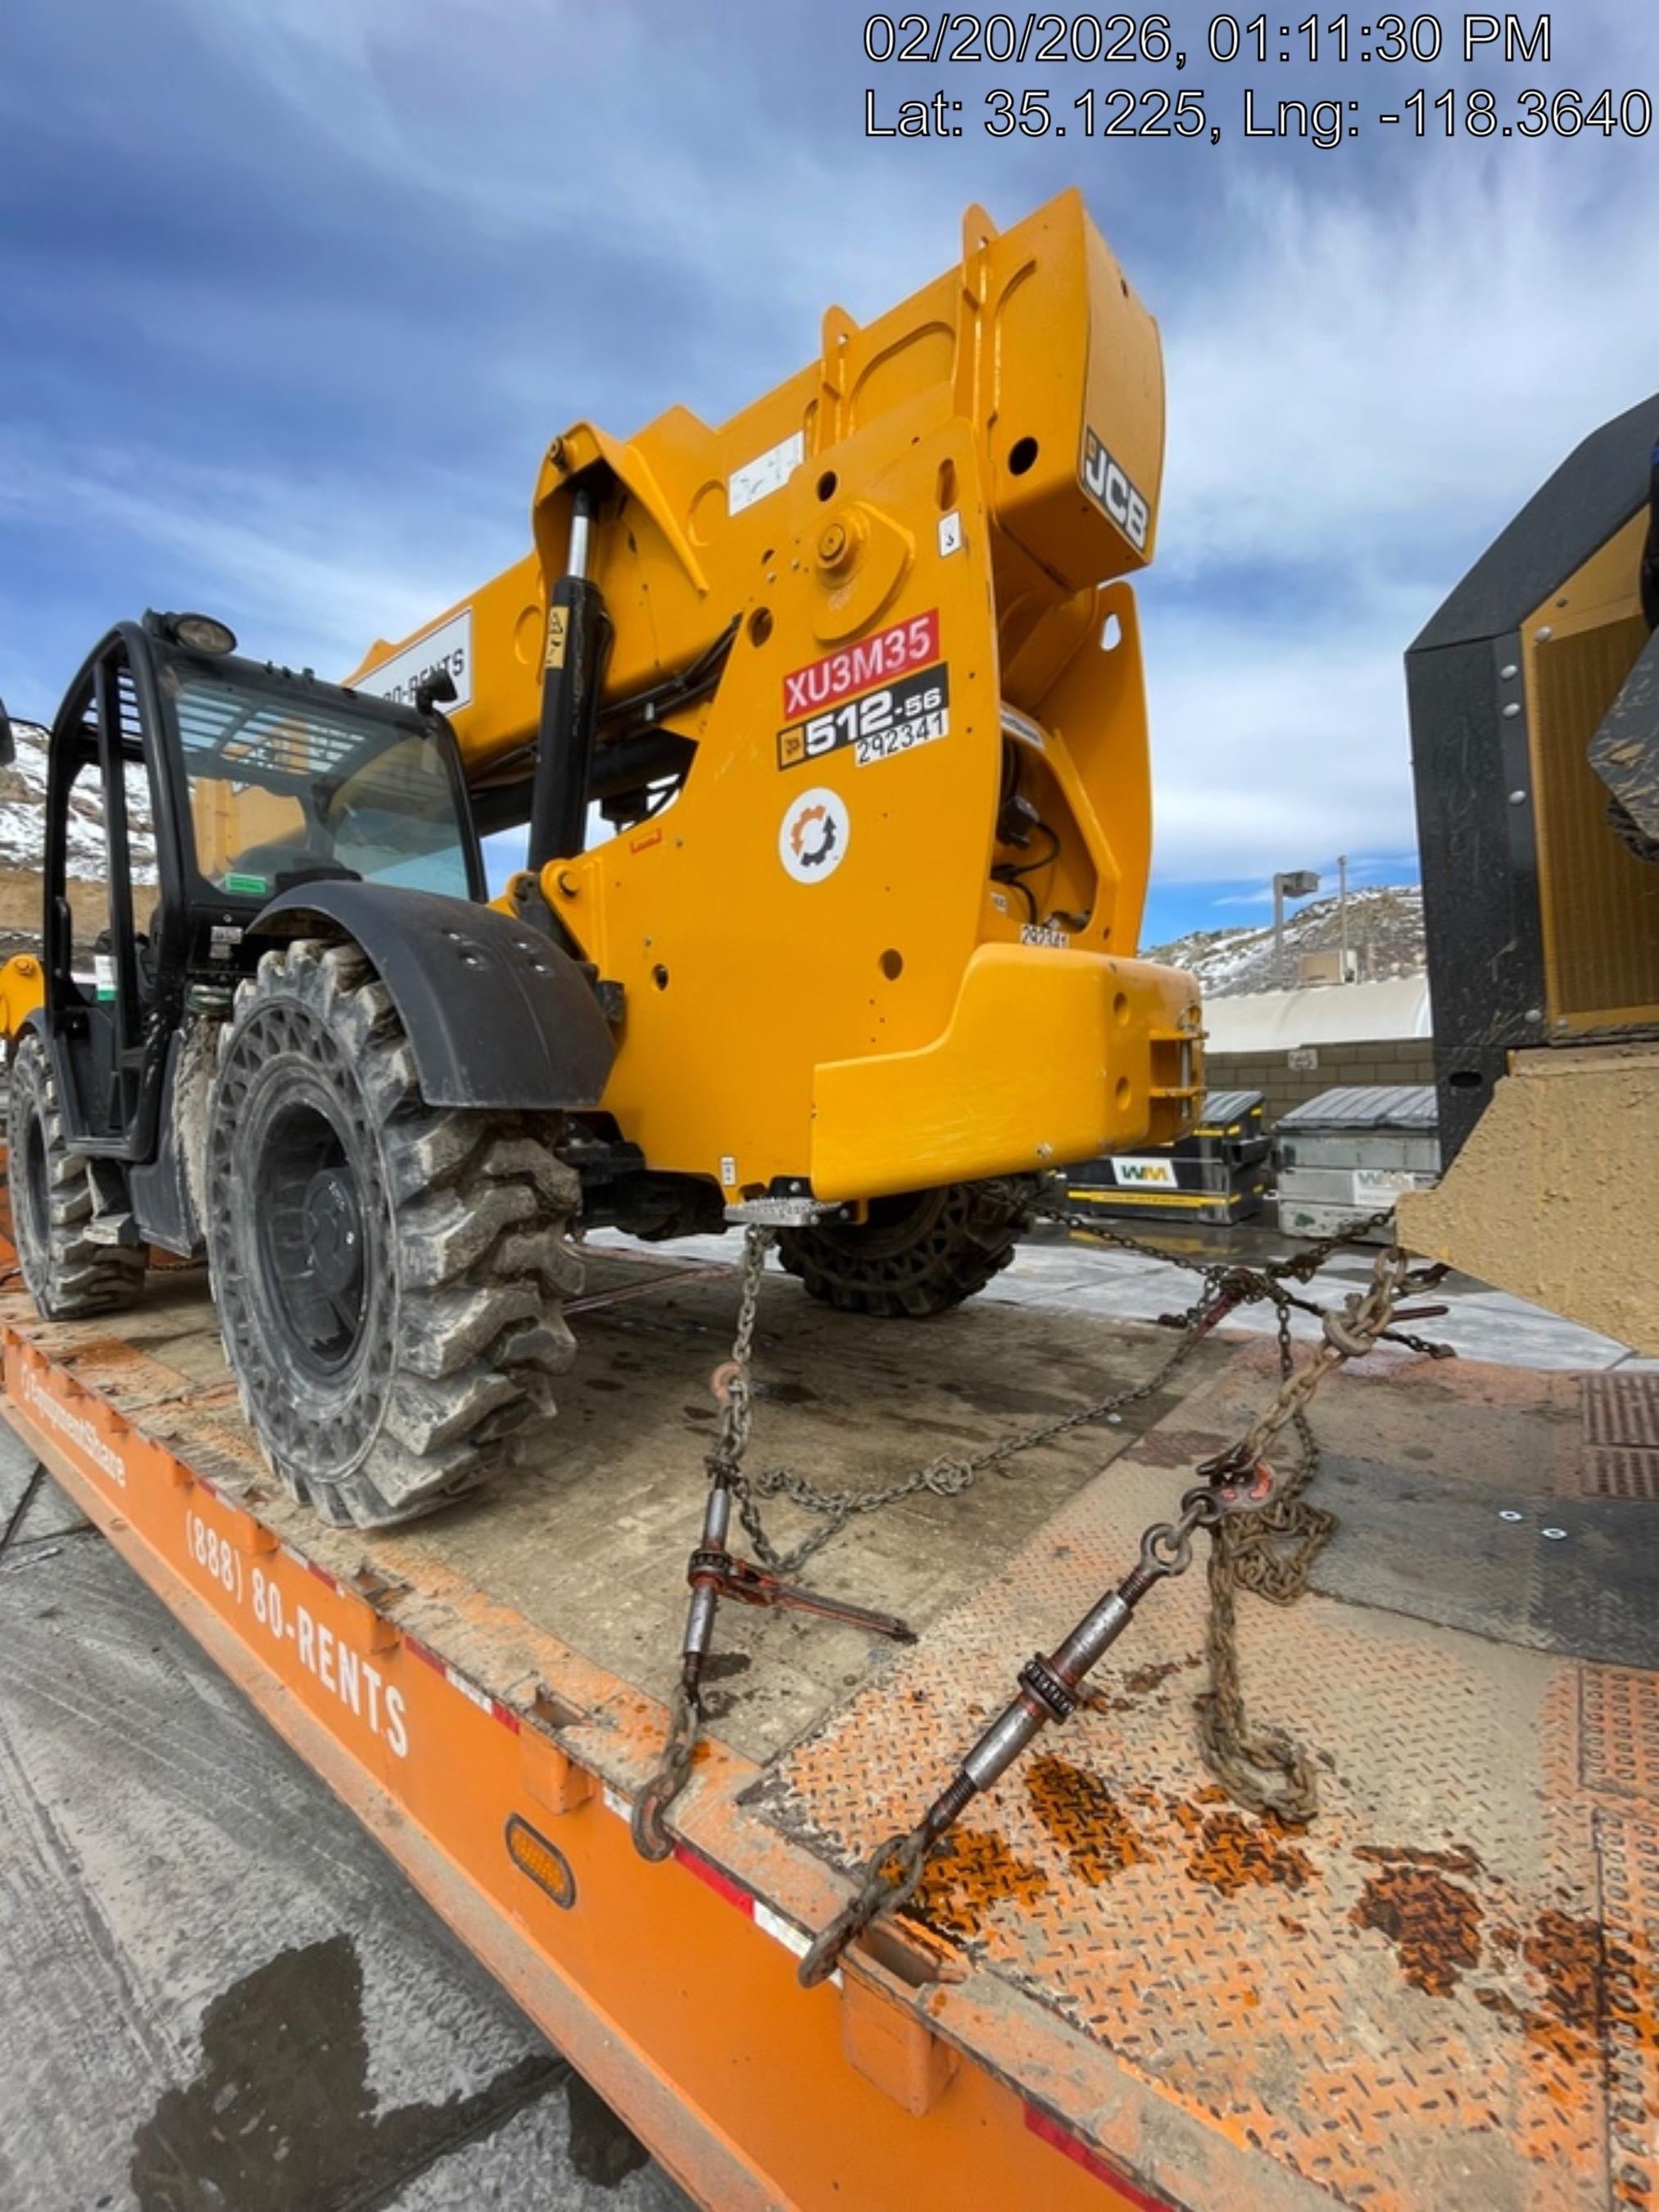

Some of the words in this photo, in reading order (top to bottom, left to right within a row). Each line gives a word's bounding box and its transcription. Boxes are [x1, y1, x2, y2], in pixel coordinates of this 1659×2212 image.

[1086, 449, 1148, 548] JCB
[786, 616, 931, 714] XU3M35
[857, 712, 945, 764] 292341
[1121, 1165, 1167, 1181] WM
[186, 1509, 243, 1605] (888)
[252, 1566, 408, 1759] 80-RENTS
